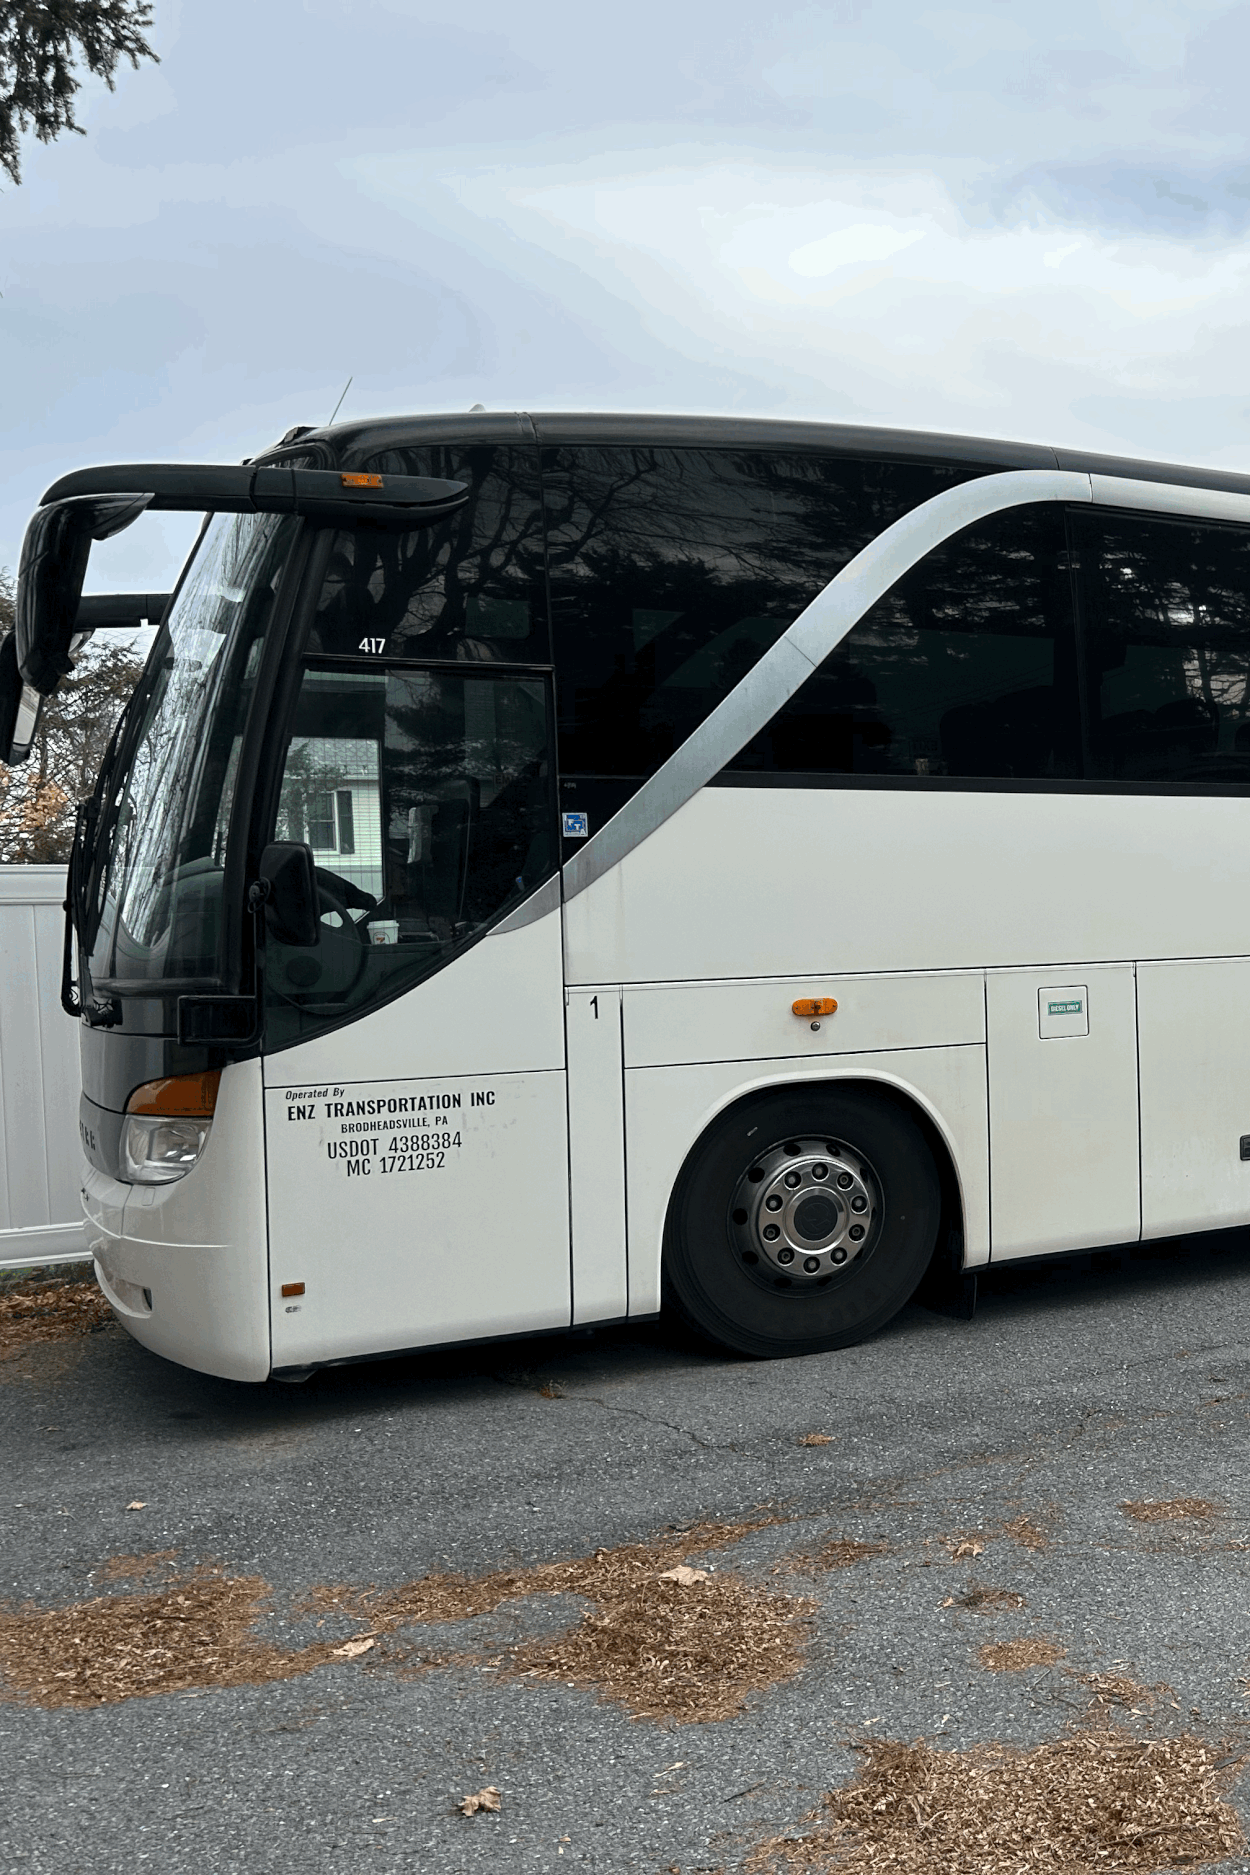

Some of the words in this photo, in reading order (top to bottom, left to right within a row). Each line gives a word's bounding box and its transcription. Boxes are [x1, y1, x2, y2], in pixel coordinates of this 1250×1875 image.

[358, 637, 386, 654] 417
[589, 995, 599, 1020] 1
[285, 1087, 329, 1101] Operated
[332, 1087, 345, 1098] By
[287, 1104, 316, 1121] ENZ
[324, 1093, 462, 1118] TRANSPORTATION
[470, 1090, 496, 1106] INC
[340, 1117, 431, 1134] BRODHEADSVILLE,
[435, 1115, 449, 1126] PA
[327, 1138, 380, 1159] USDOT
[388, 1131, 463, 1154] 4388384
[346, 1158, 371, 1177] MC
[379, 1151, 446, 1174] 1721252
